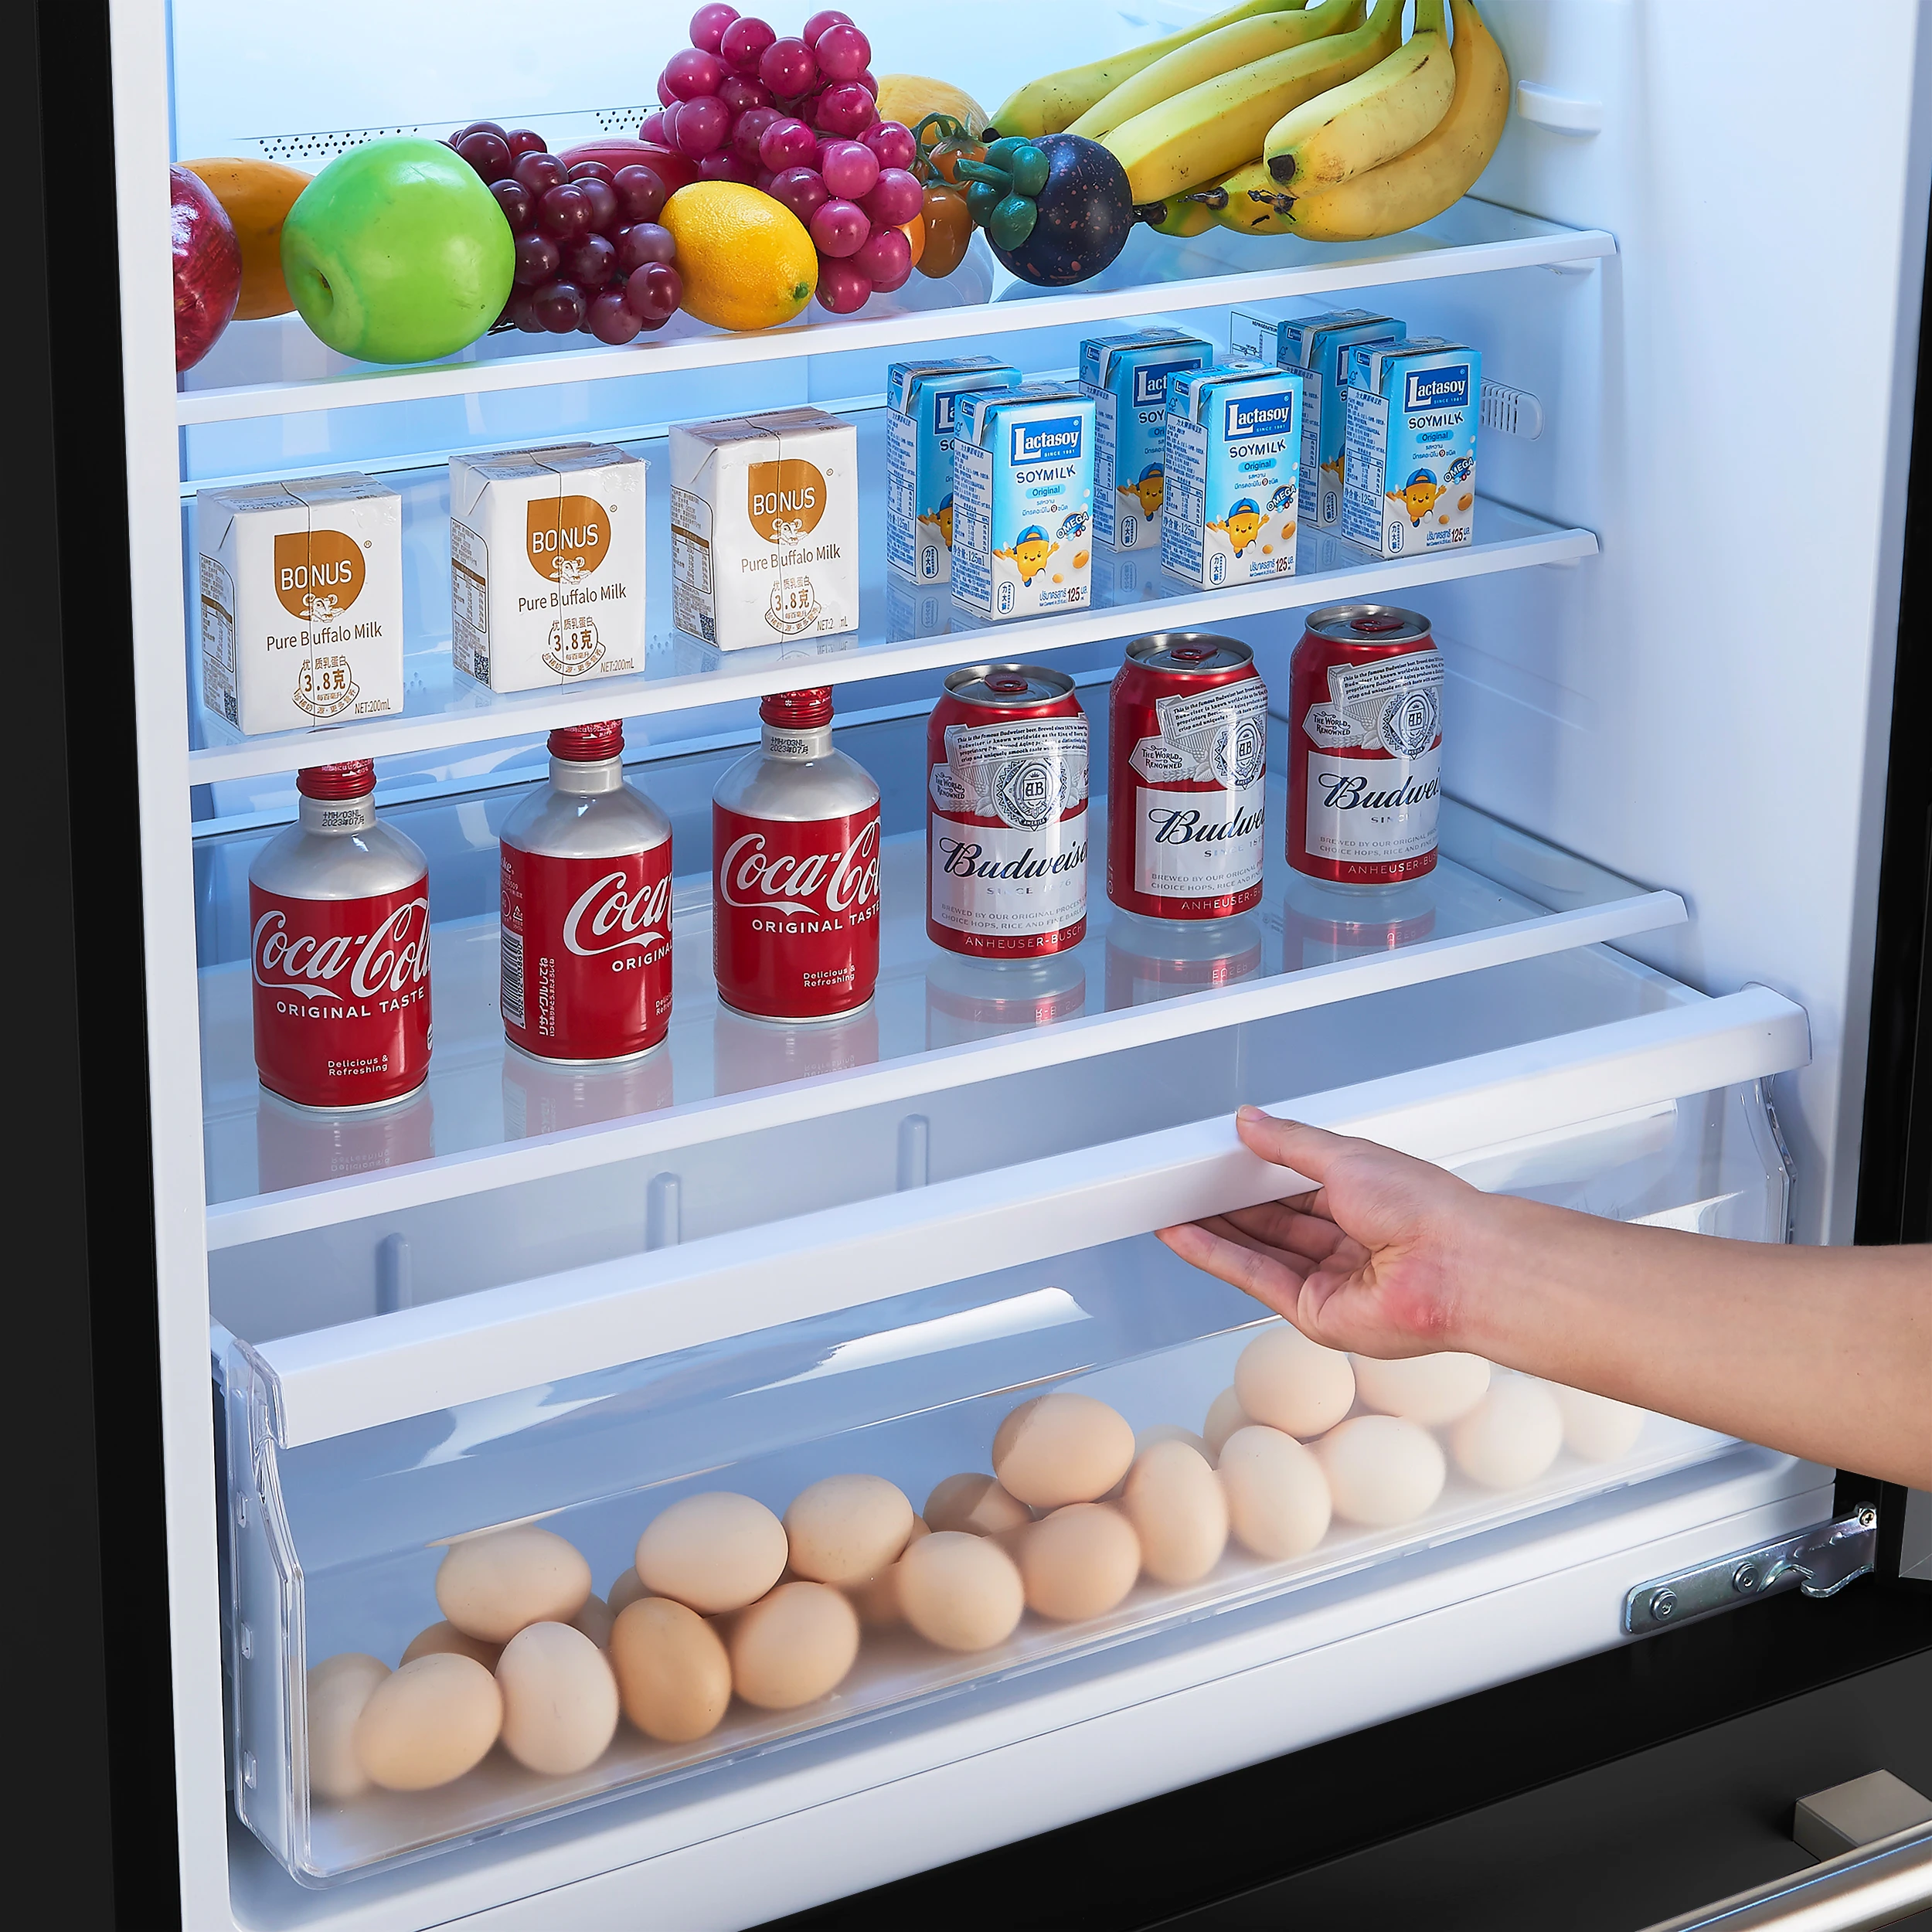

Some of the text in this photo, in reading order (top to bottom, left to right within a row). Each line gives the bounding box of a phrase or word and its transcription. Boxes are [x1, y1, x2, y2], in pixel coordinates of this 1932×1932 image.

[1408, 377, 1465, 407] Lactasoy
[1228, 404, 1289, 436] Lactasoy
[1409, 412, 1464, 429] SOYMILK
[1015, 428, 1080, 461] Lactasoy
[1422, 431, 1448, 442] Original
[1230, 439, 1286, 458] SOYMILK
[1016, 464, 1076, 483] SOYMILK
[1244, 461, 1271, 471] Original
[1444, 457, 1474, 482] OMEGA
[753, 487, 815, 515] BONUS
[1032, 486, 1060, 497] Original
[1267, 485, 1297, 512] OMEGA
[1056, 512, 1089, 539] OMEGA
[1451, 528, 1463, 543] 125
[532, 524, 599, 553] BONUS
[742, 543, 841, 573] Pure Buffalo Milk
[1276, 557, 1287, 572] 125
[281, 560, 352, 590] BONUS
[774, 575, 809, 591] 优质乳蛋白
[519, 583, 627, 612] Pure Buffalo Milk
[775, 589, 809, 611] 3.8克
[1067, 587, 1080, 602] 125
[553, 616, 593, 631] 优质乳蛋白
[267, 621, 383, 651] Pure Buffalo Milk
[553, 629, 592, 651] 3.8克
[302, 655, 346, 671] 优质乳蛋白
[304, 668, 345, 692] 3.8克
[1393, 834, 1426, 845] ORIGINAL
[1226, 866, 1256, 878] ORIGINAL
[1217, 880, 1235, 889] RICE
[752, 900, 879, 934] ORIGINAL TASTE
[941, 903, 972, 917] BREWED
[1012, 910, 1053, 920] ORIGINAL
[1056, 898, 1082, 914] PROCESS
[941, 913, 968, 925] CHOICE
[1046, 917, 1064, 925] FINE
[965, 925, 1082, 948] ANHEUSER-BUSCH
[803, 968, 847, 979] Delicious
[804, 974, 854, 987] Refreshing
[277, 986, 424, 1019] ORIGINAL TASTE
[539, 957, 549, 1036] リサイクルしてね
[328, 1057, 379, 1068] Delicious
[328, 1064, 388, 1076] Refreshing
